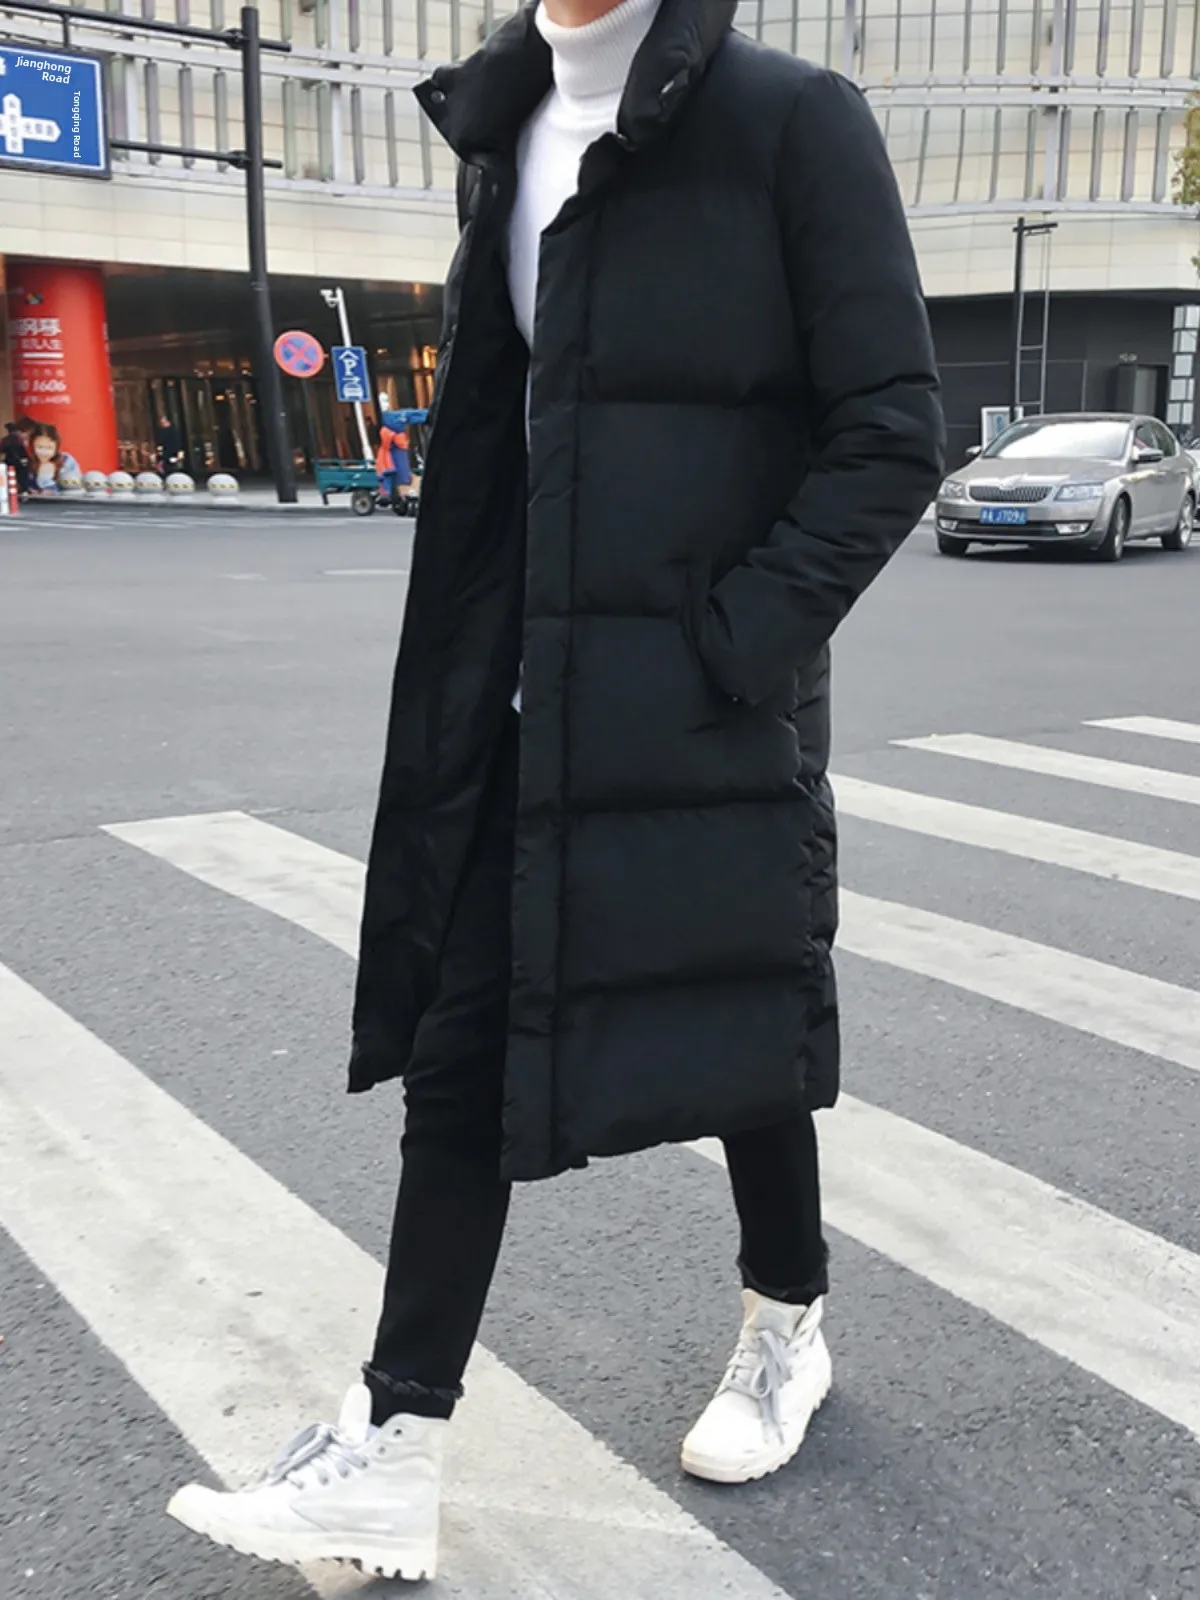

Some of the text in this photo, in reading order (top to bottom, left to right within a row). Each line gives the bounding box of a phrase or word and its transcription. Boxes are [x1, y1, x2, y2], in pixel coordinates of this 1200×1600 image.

[15, 56, 71, 74] Jianghong
[42, 71, 70, 84] Road
[72, 90, 82, 158] Tongqing Road
[342, 356, 357, 376] P
